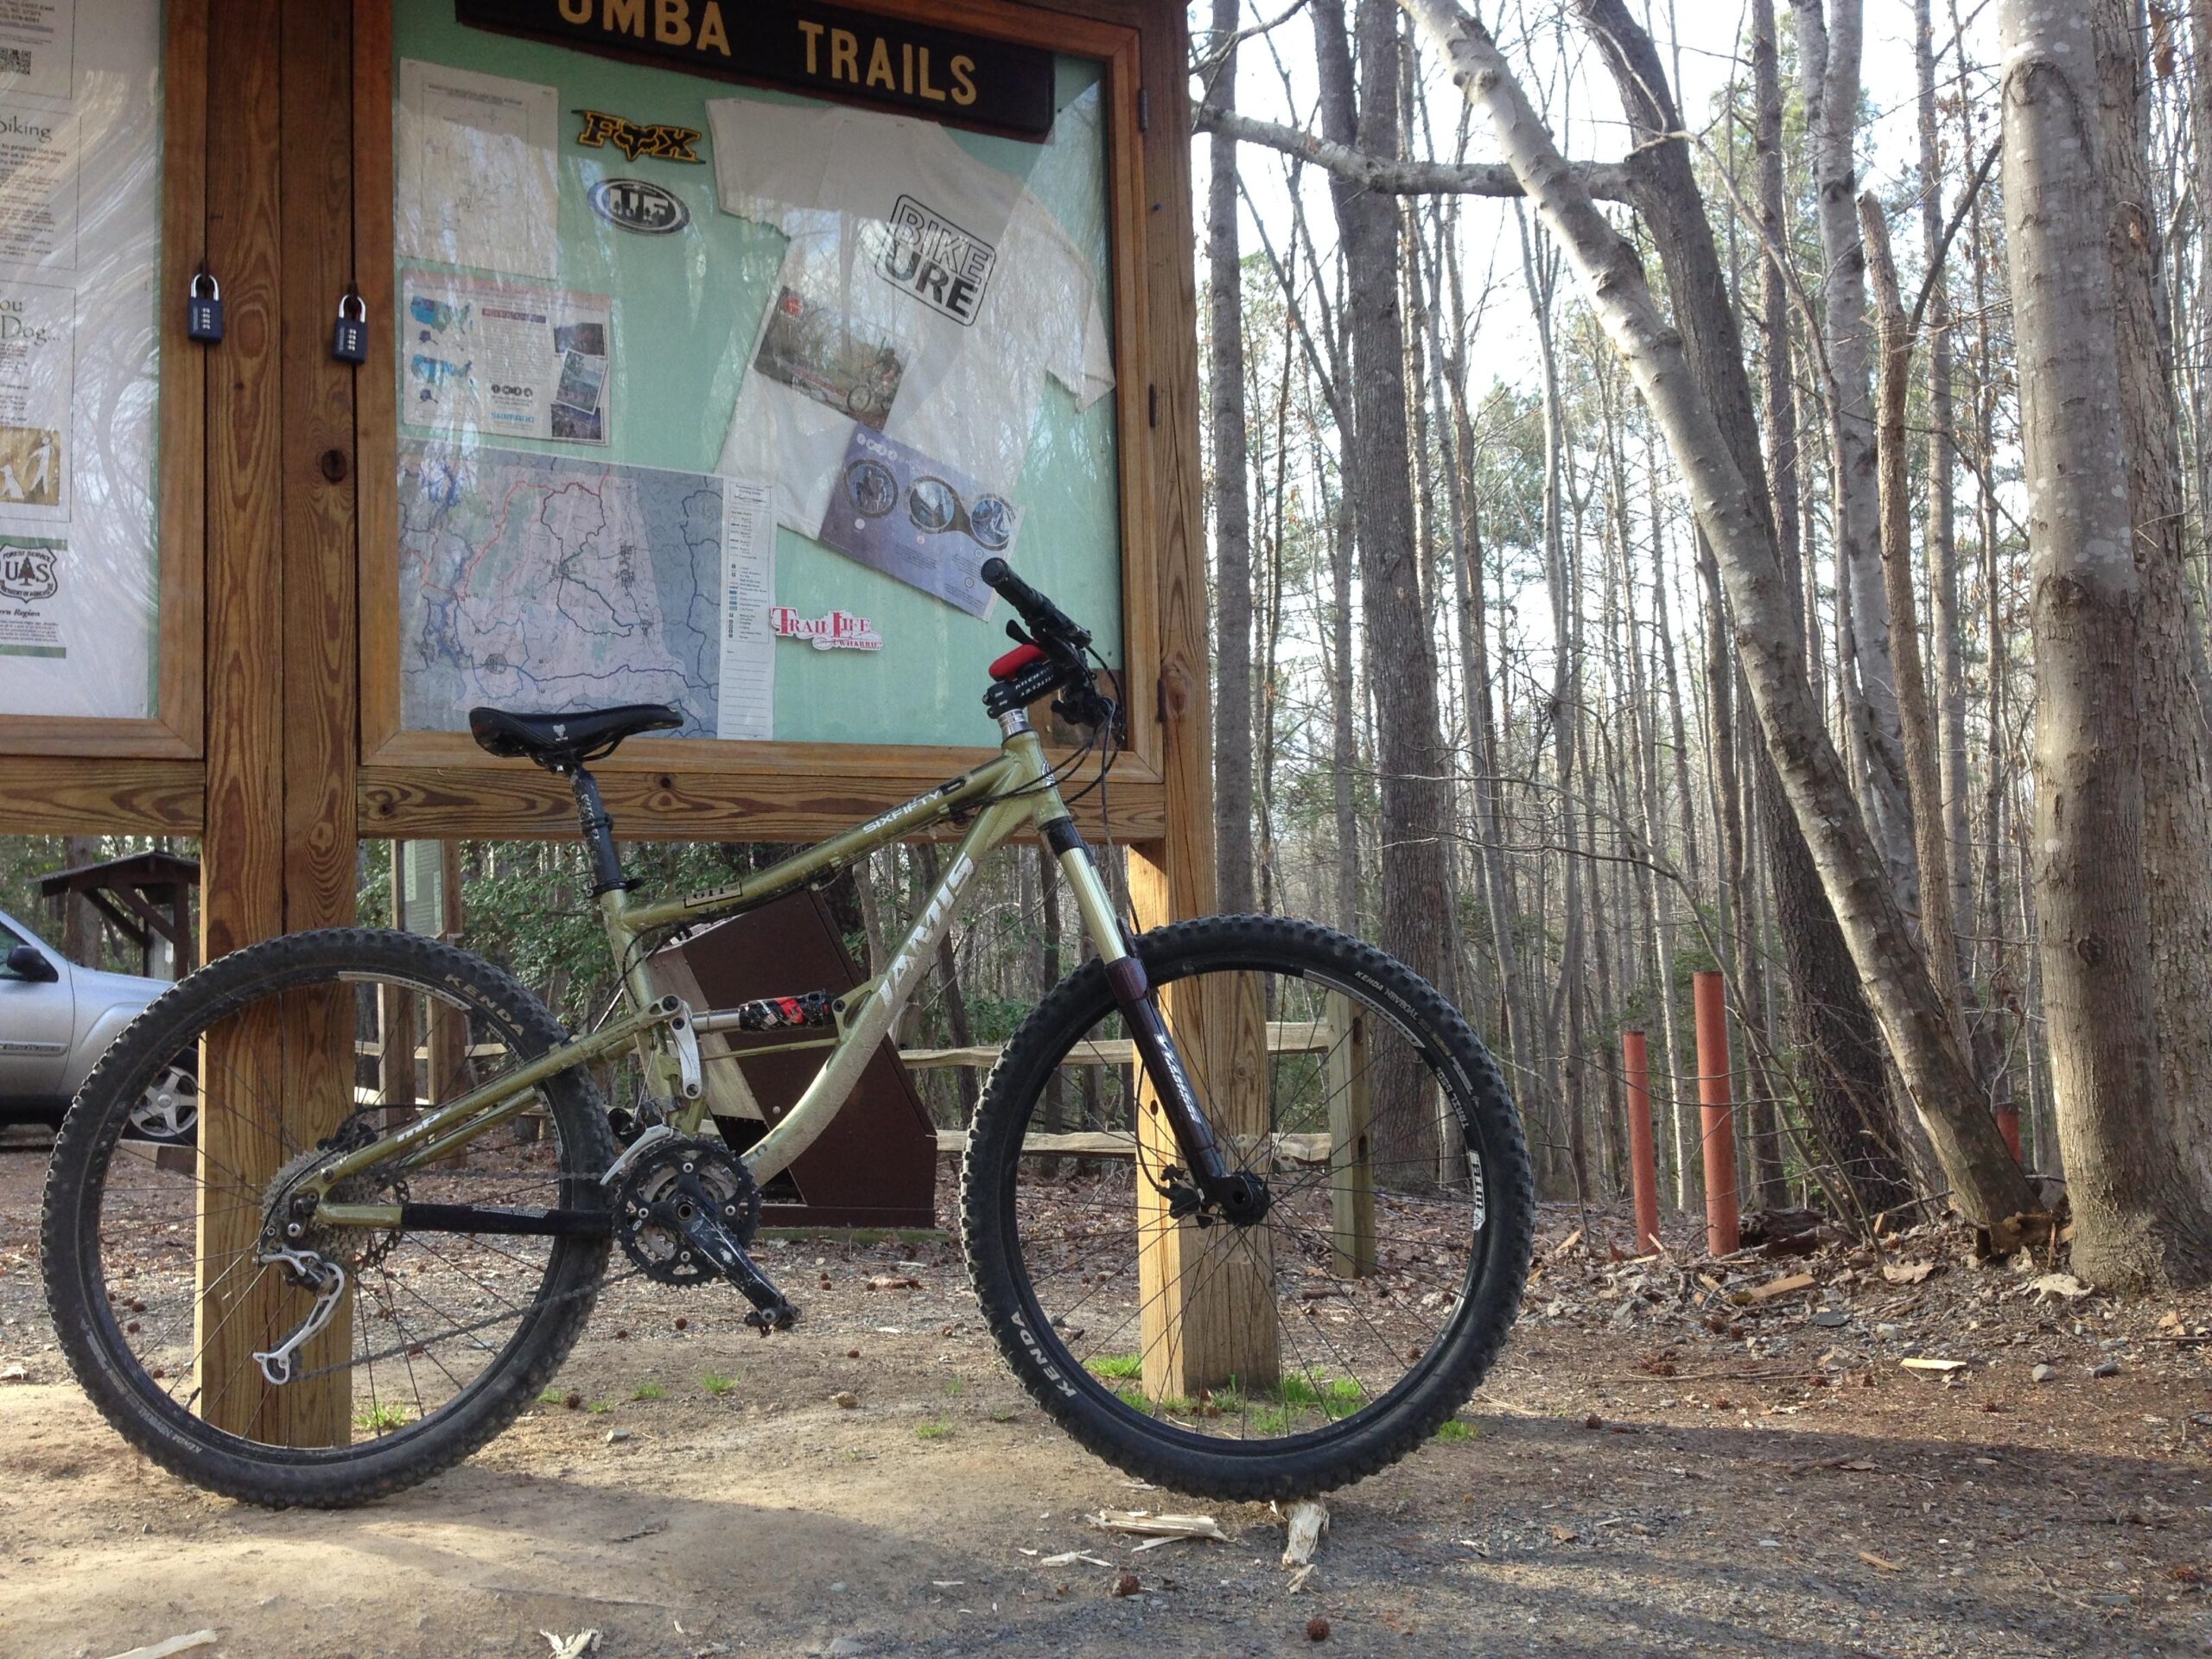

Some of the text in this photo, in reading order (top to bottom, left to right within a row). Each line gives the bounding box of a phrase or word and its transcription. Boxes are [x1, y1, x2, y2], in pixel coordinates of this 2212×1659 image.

[798, 20, 978, 105] TRAILS
[571, 110, 707, 164] FOX
[893, 203, 989, 286] BIKE
[0, 301, 22, 312] ou
[885, 237, 979, 319] URE
[14, 608, 41, 619] Region
[862, 790, 943, 835] SIXFIFTY
[443, 973, 525, 1037] KENDA
[1354, 969, 1384, 992] KENDA
[1010, 1311, 1077, 1398] KENDA
